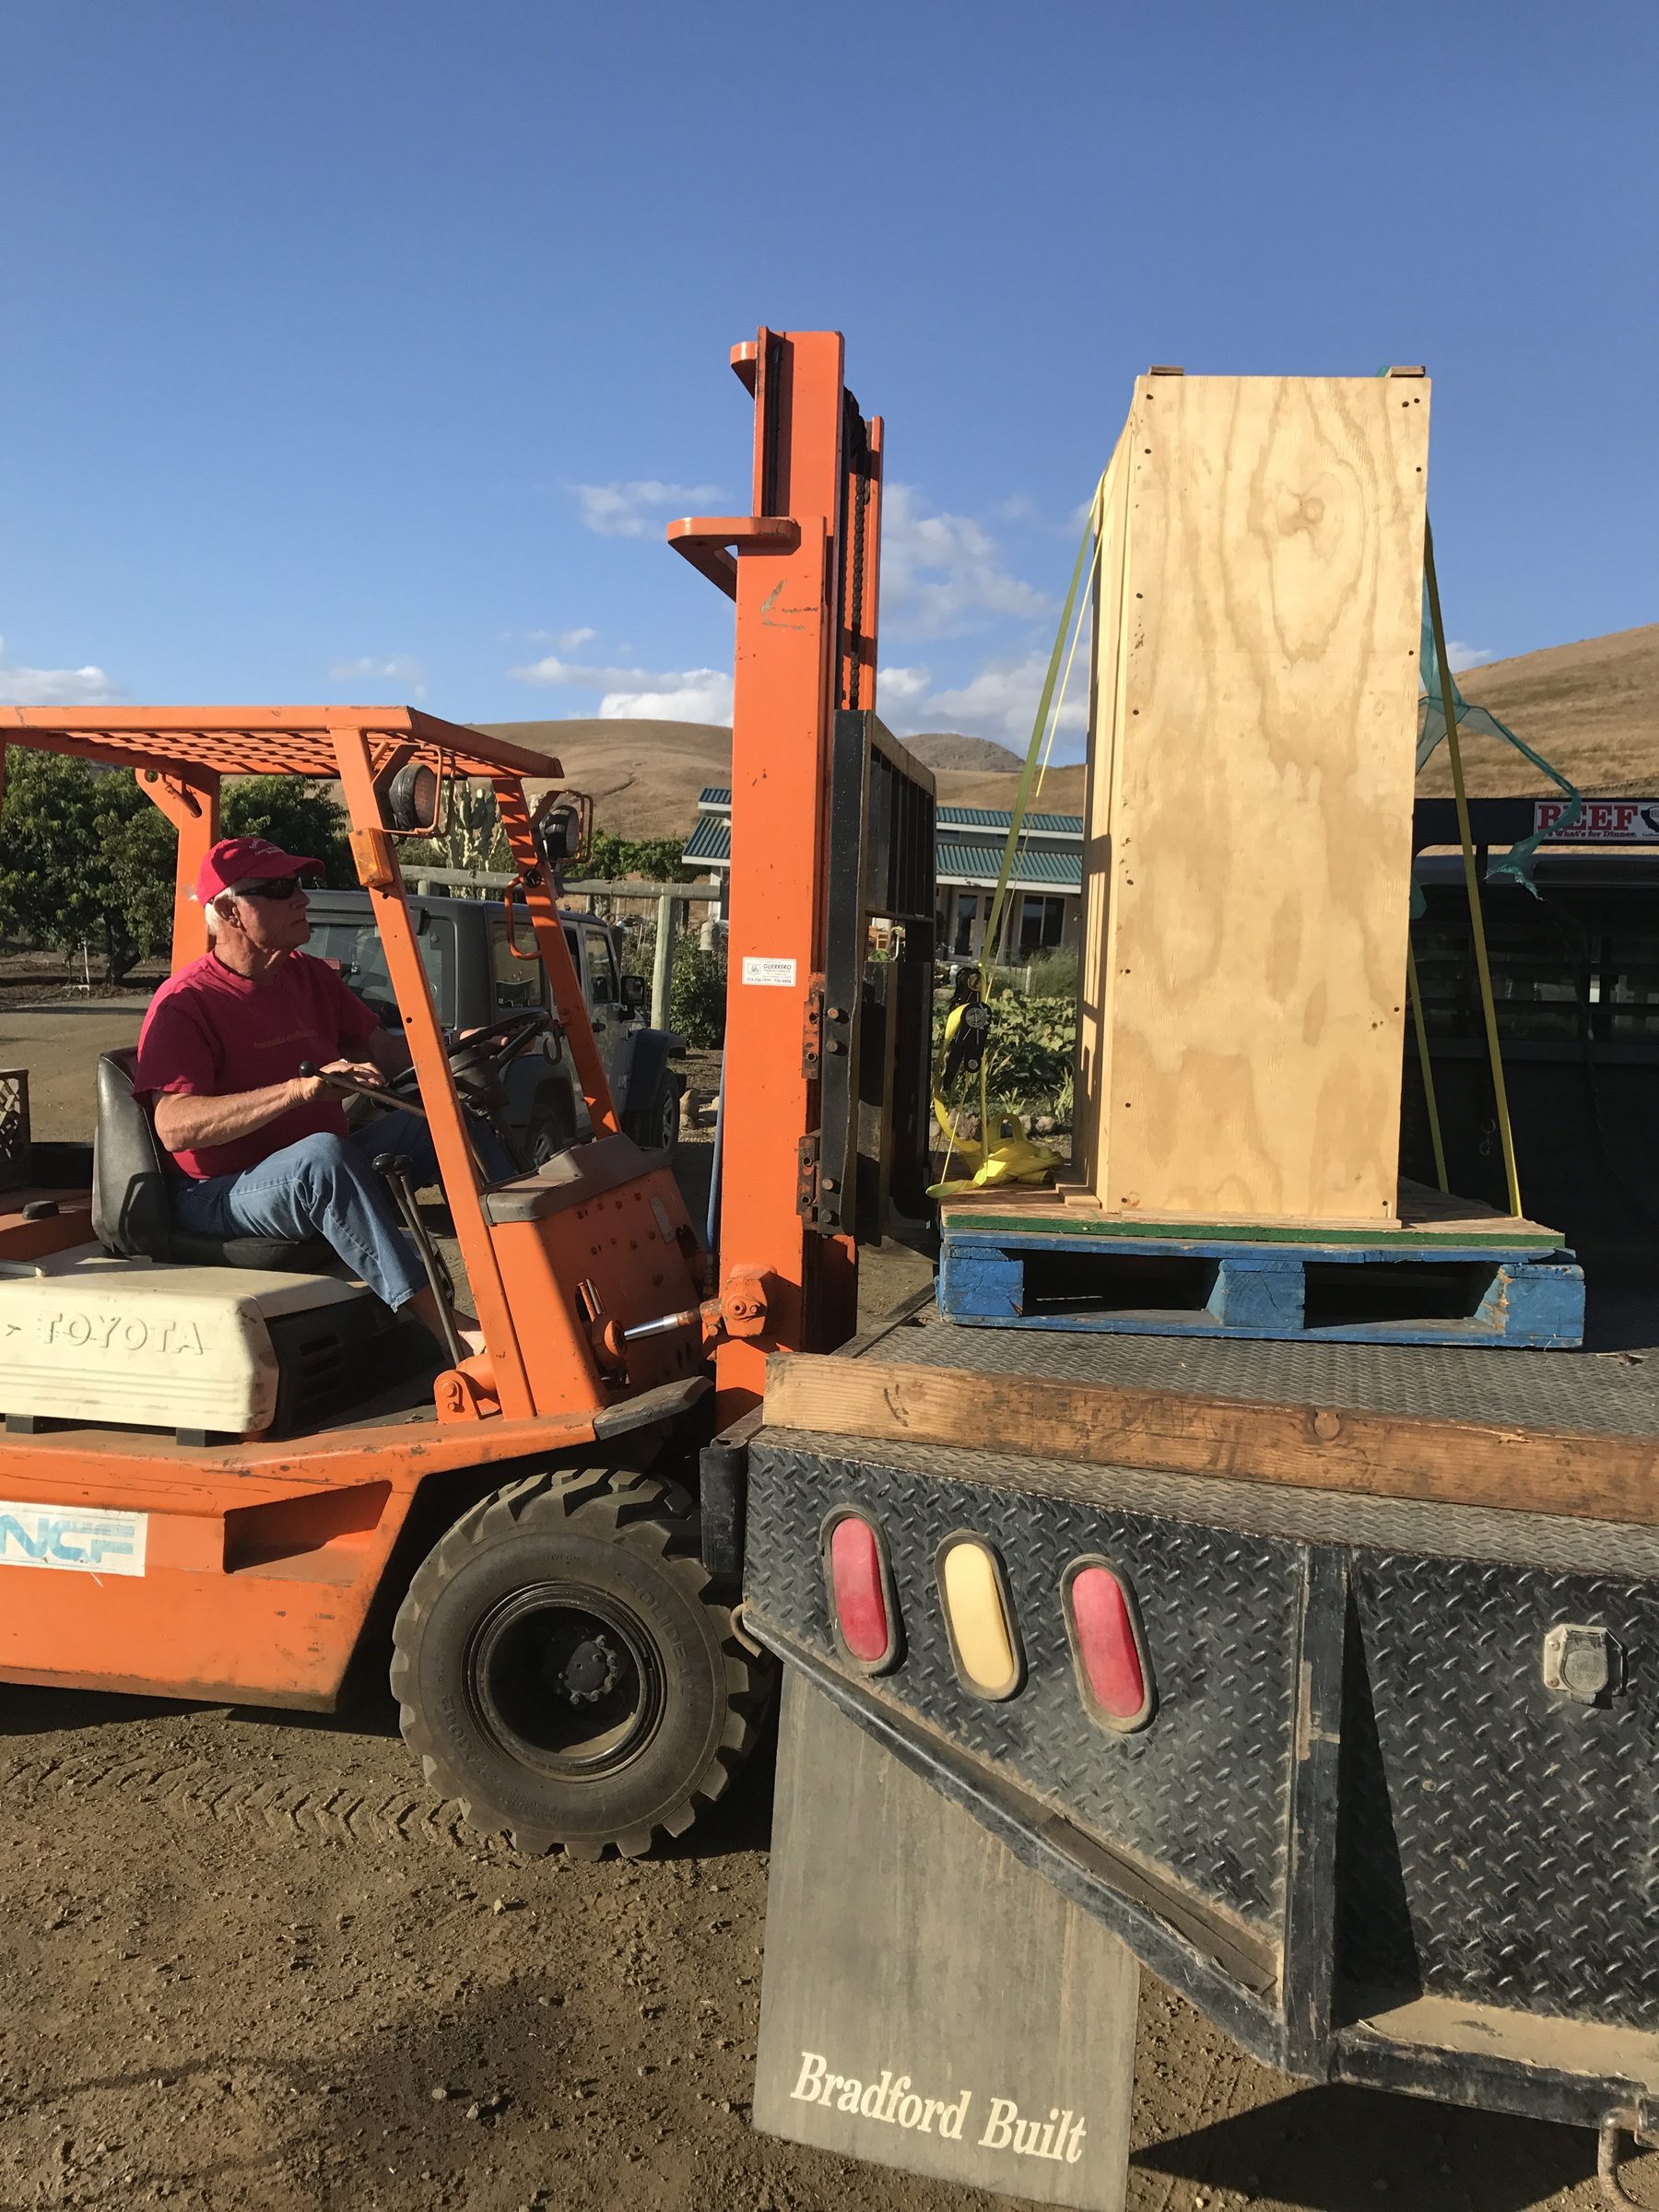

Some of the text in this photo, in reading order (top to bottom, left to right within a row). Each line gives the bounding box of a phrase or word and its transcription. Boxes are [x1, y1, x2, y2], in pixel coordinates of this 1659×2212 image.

[38, 1312, 204, 1355] TOYOTA
[790, 2051, 1087, 2164] Bradford Built
